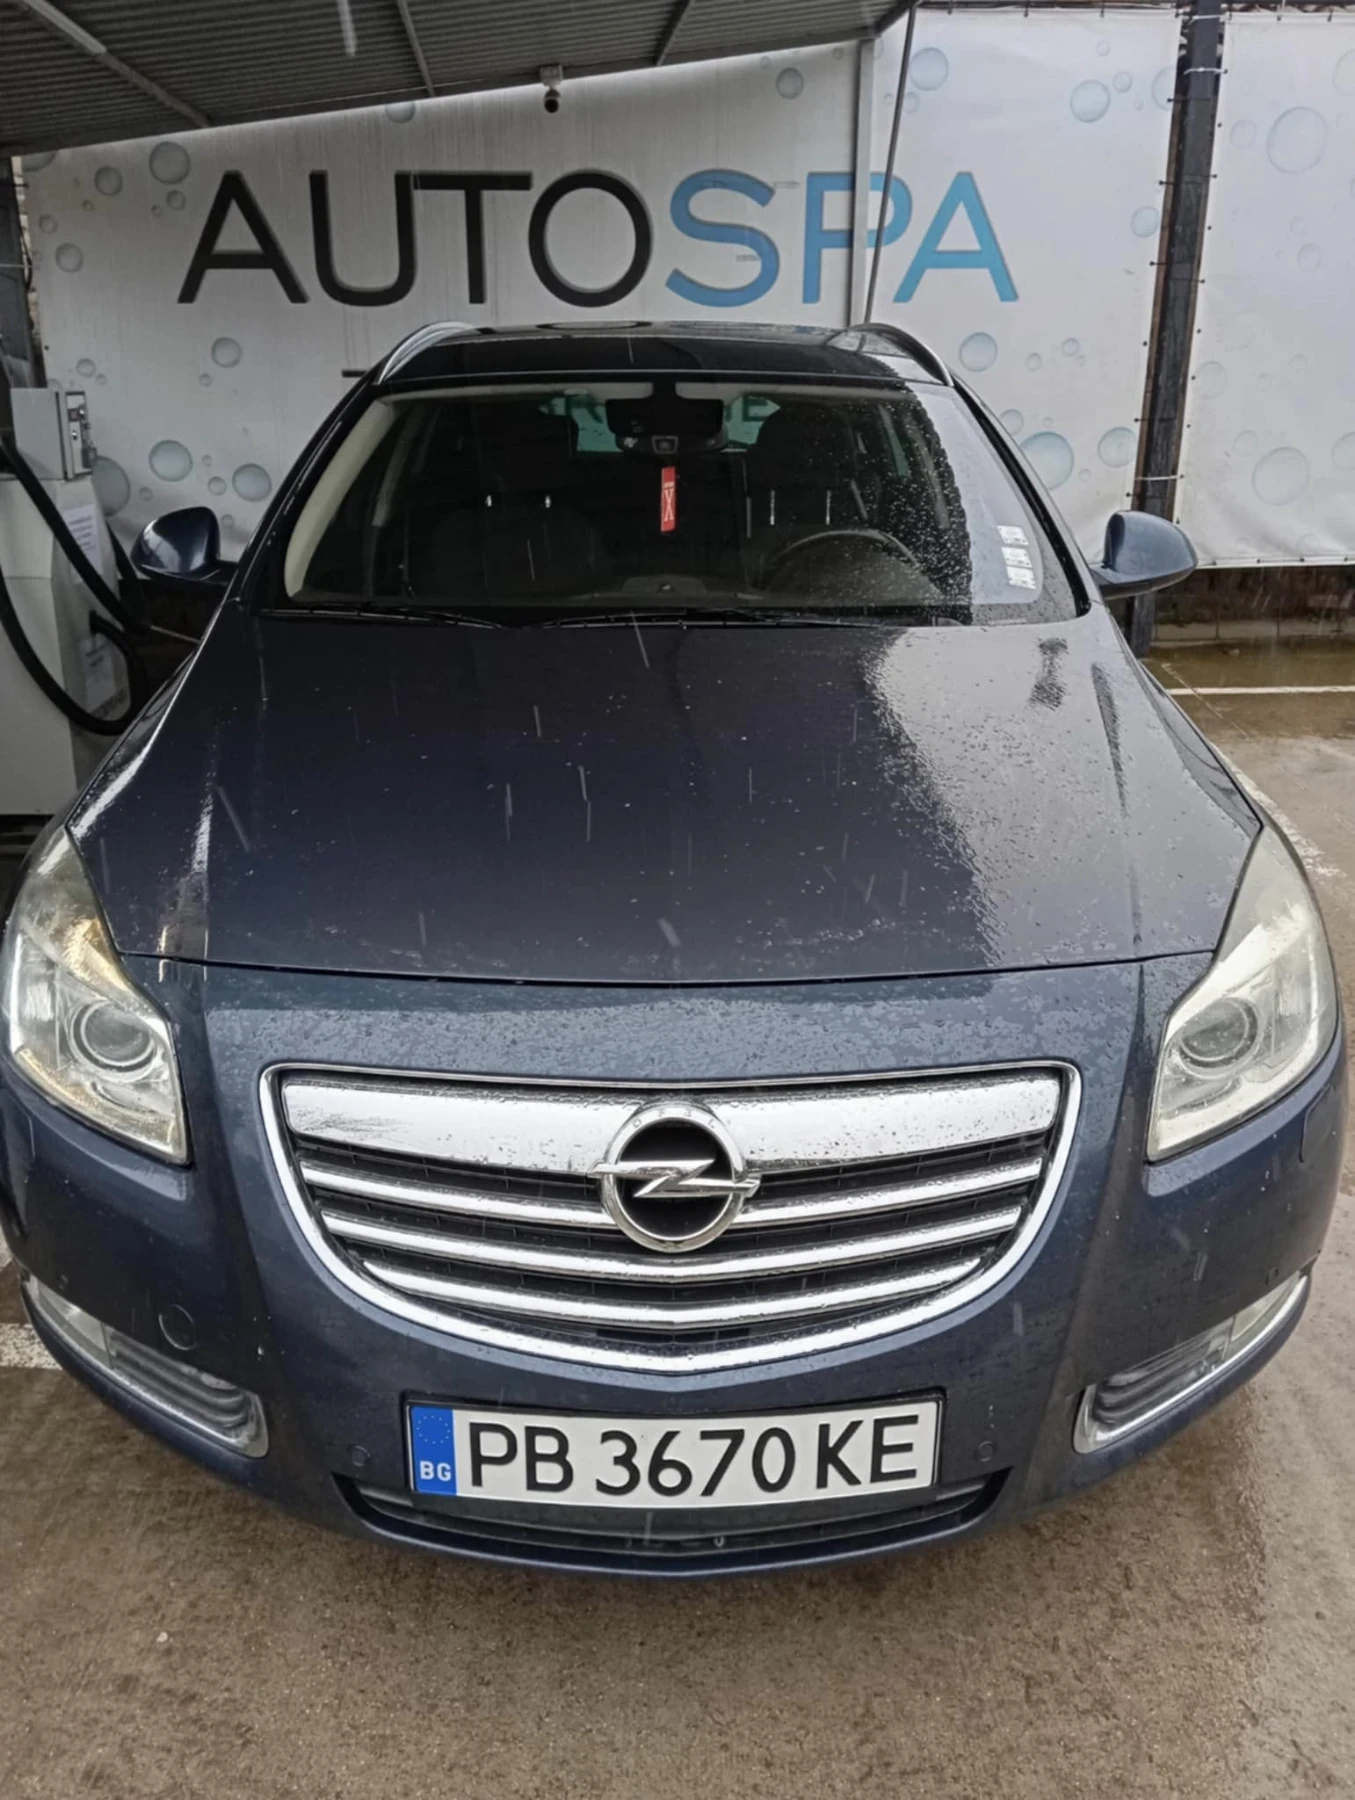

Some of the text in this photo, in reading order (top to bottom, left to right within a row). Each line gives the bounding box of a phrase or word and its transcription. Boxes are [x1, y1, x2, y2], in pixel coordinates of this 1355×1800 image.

[419, 1460, 452, 1482] BG
[469, 1415, 920, 1497] PB 3670 KE
